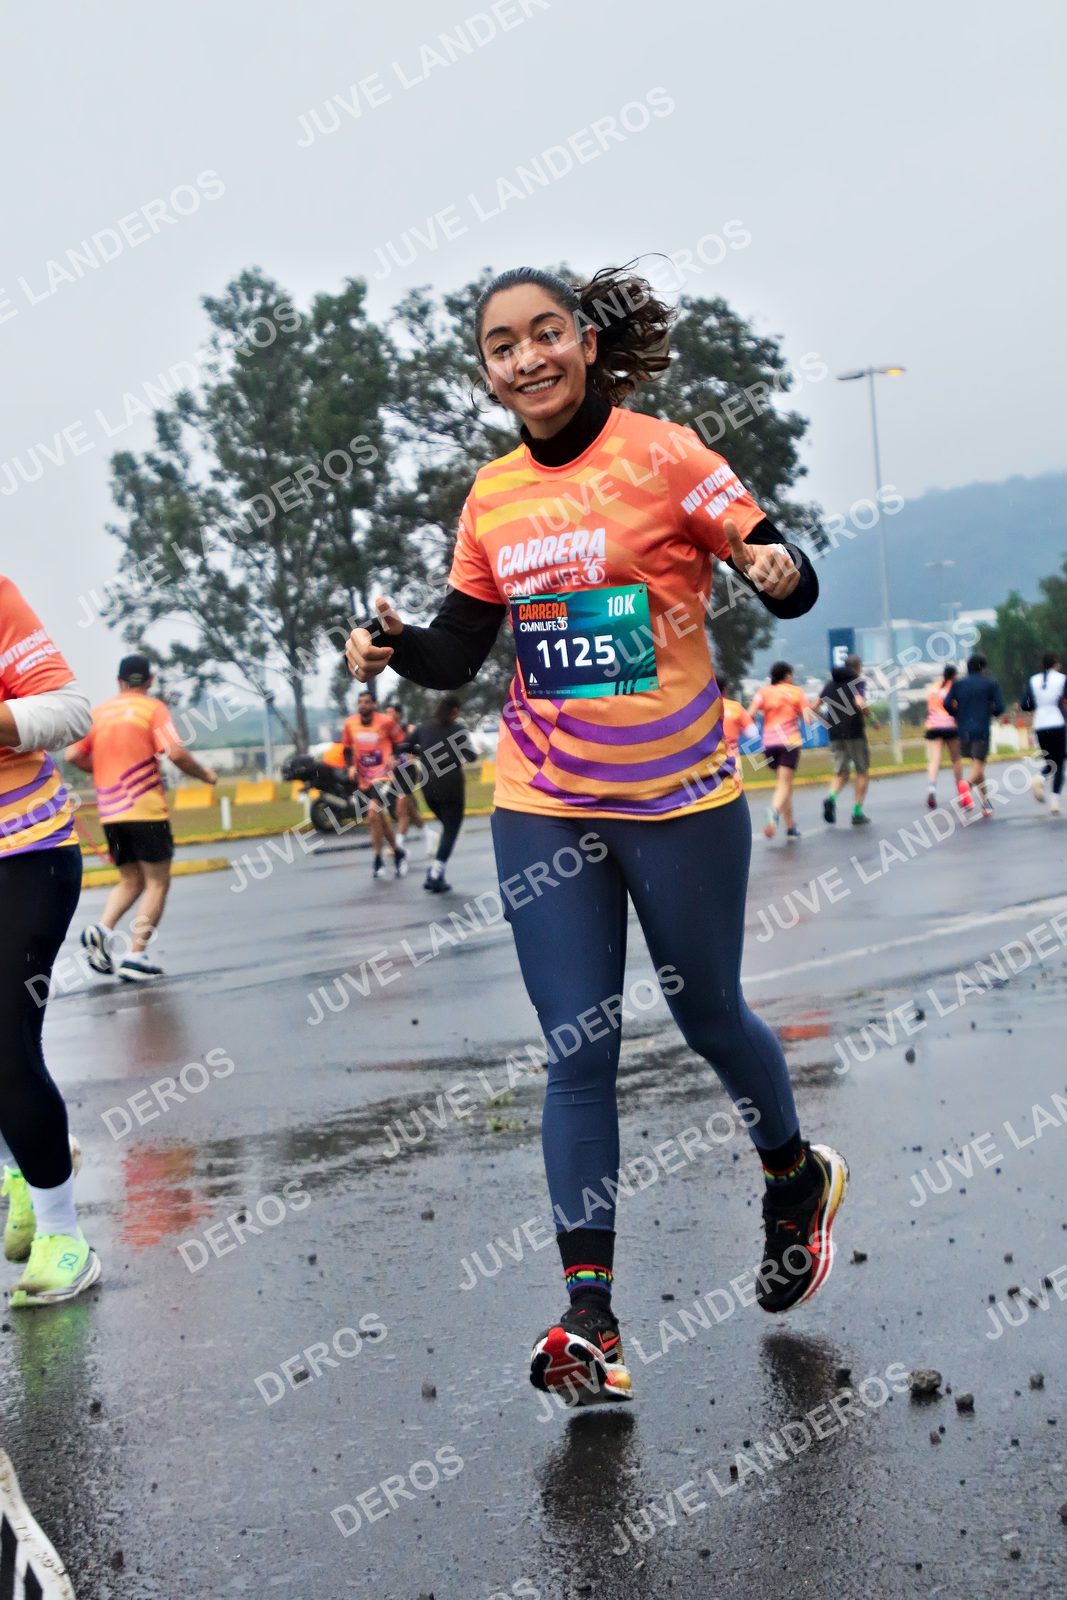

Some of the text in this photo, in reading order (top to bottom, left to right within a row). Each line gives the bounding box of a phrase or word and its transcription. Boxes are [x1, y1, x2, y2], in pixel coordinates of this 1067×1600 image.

[497, 527, 607, 578] CARRERA
[518, 602, 568, 621] CARRERA
[606, 594, 636, 617] 10K
[536, 634, 616, 668] 1125
